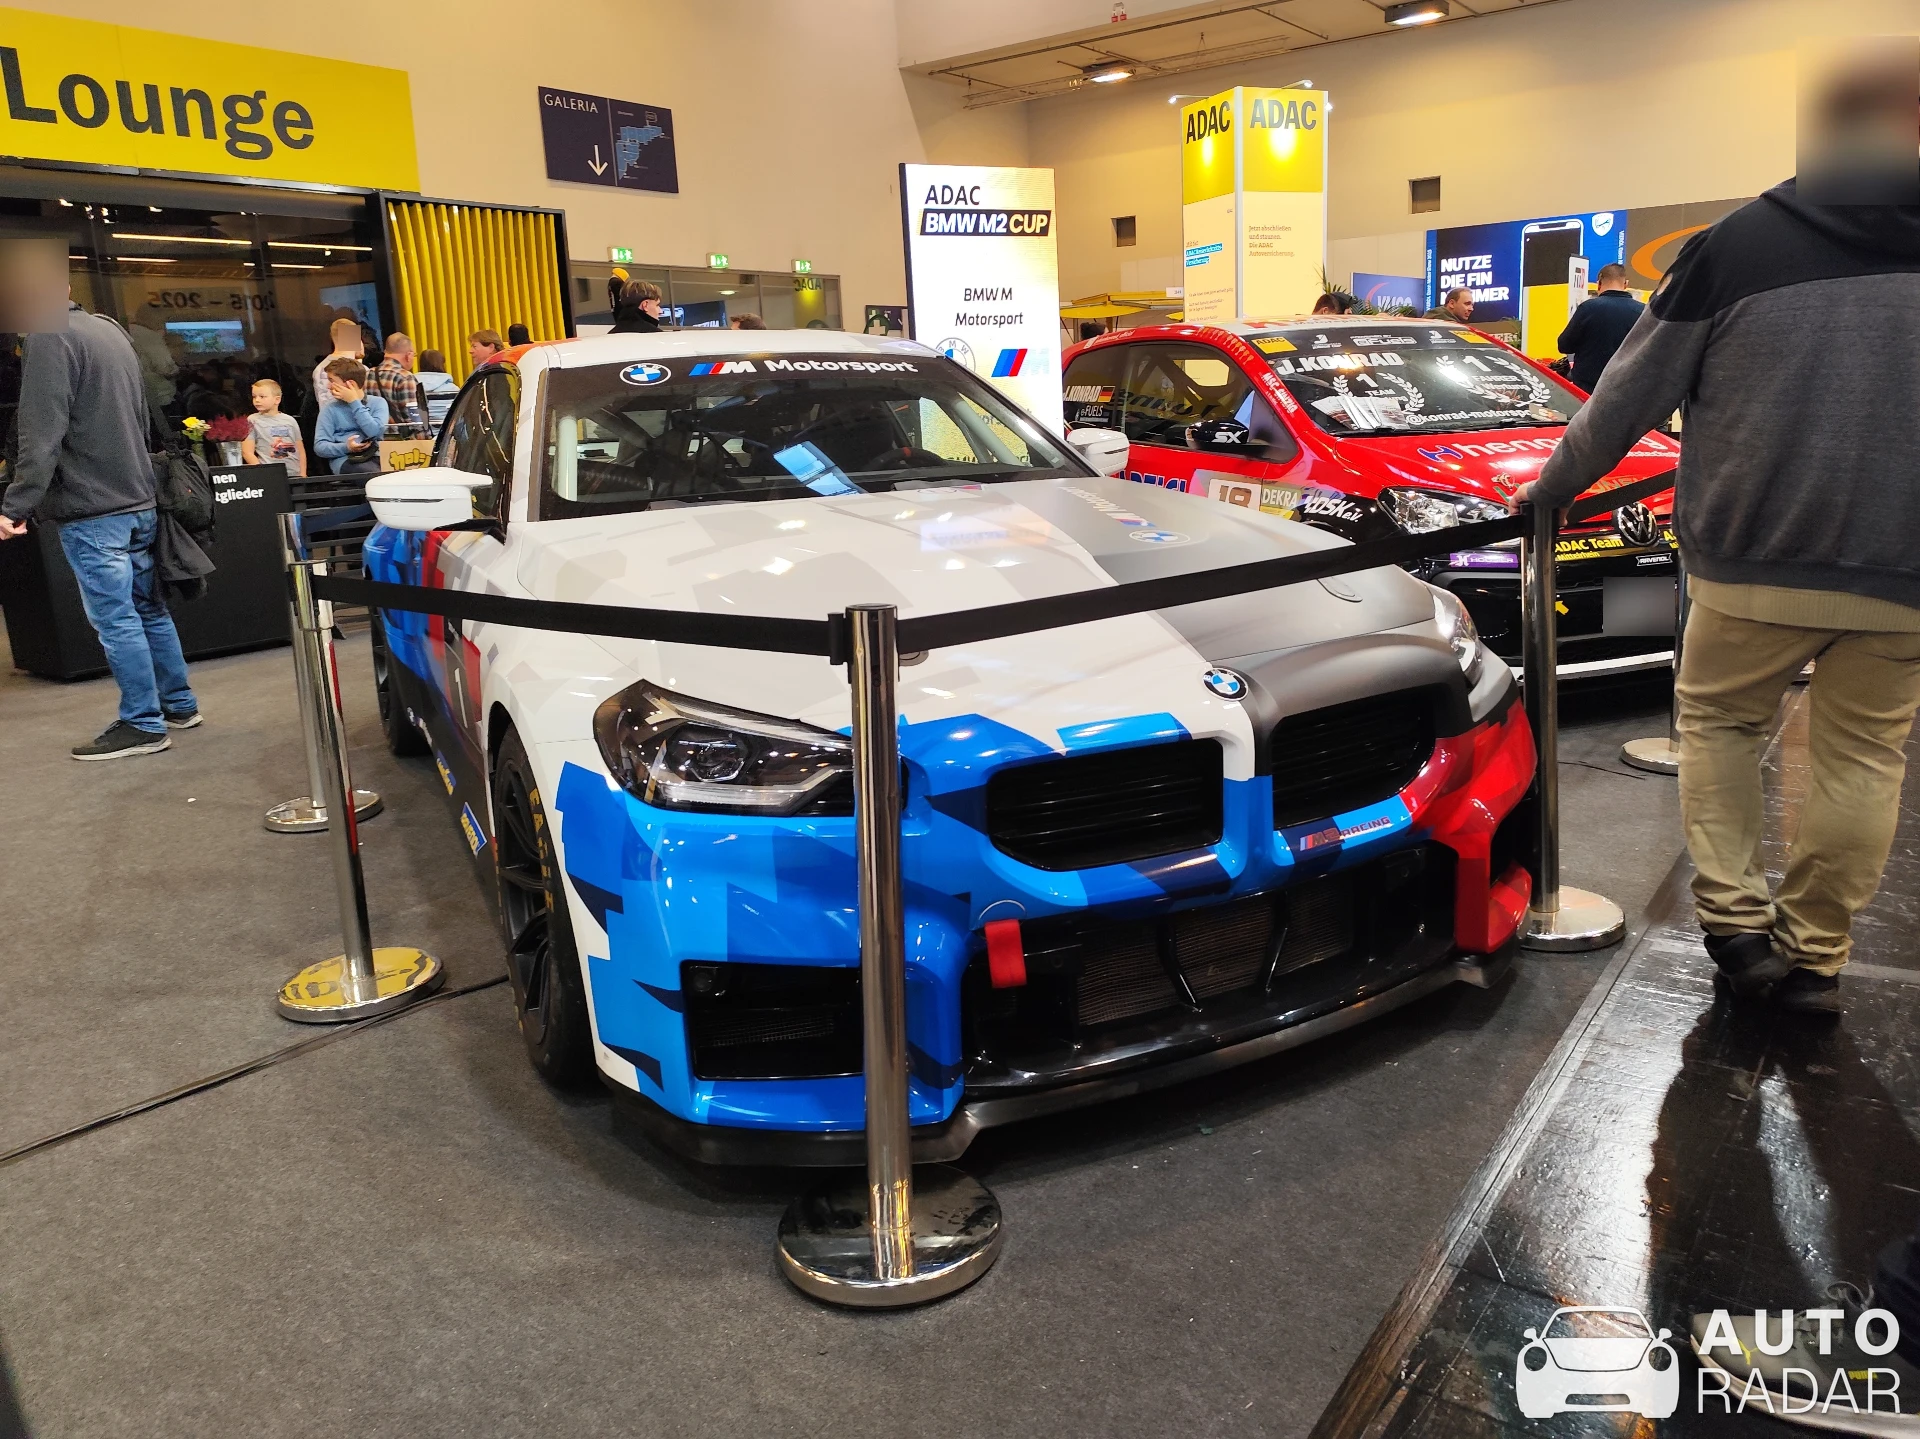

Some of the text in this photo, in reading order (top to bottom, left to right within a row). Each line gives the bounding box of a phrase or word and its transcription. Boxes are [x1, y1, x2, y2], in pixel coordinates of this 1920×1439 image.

[0, 46, 314, 160] Lounge
[544, 94, 598, 114] GALERIA
[1186, 100, 1231, 144] ADAC
[1250, 99, 1317, 131] ADAC
[925, 185, 980, 206] ADAC
[925, 213, 1048, 234] BMW M2 CUP
[1441, 254, 1493, 273] NUTZE
[1441, 271, 1493, 289] DIE FIN
[964, 287, 1013, 301] BMW M
[1440, 287, 1510, 305] NMER
[955, 312, 1023, 328] Motorsport
[1256, 337, 1286, 345] ADAC
[763, 359, 919, 375] Motorsport
[1276, 353, 1404, 375] J.KONRAD
[1463, 355, 1492, 371] 1
[1356, 373, 1379, 387] 1
[1211, 431, 1243, 444] SX
[1262, 488, 1298, 509] DEKRA
[1554, 537, 1625, 553] ADAC Team
[1340, 816, 1391, 837] RACING
